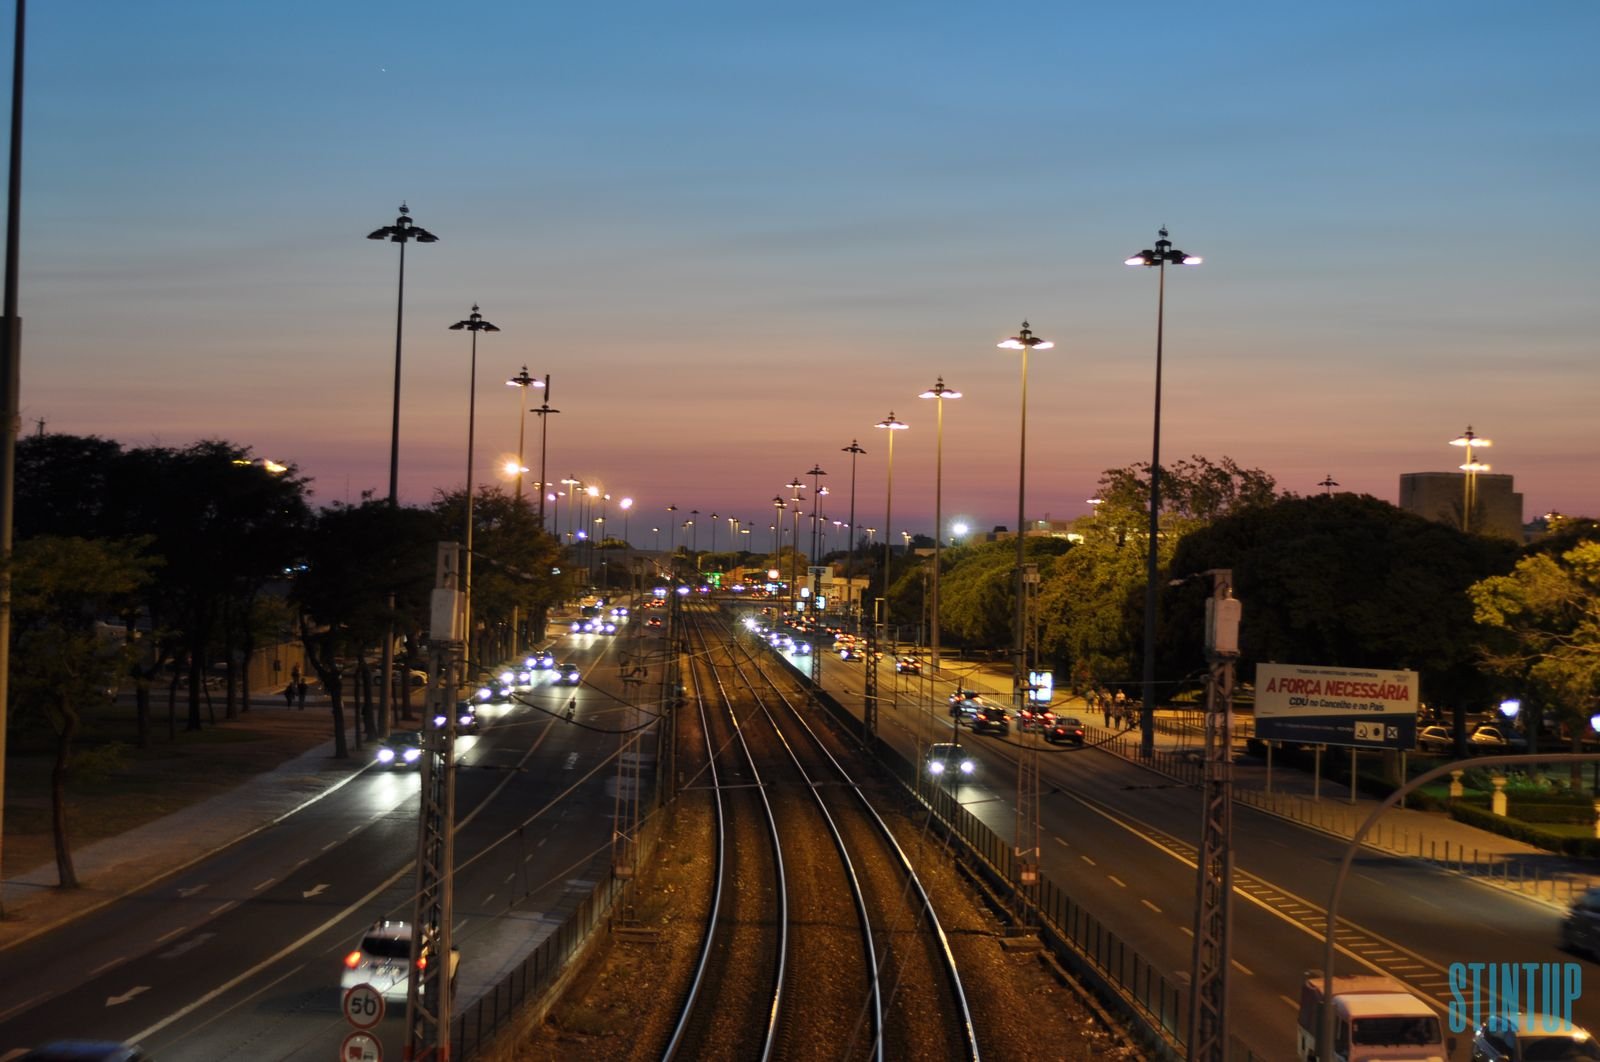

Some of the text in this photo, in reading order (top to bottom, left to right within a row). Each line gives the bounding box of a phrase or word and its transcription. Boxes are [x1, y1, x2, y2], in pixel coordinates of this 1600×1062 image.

[1266, 677, 1409, 701] A FORÇA NECESSÁRIA
[1289, 697, 1309, 706] CDU
[1319, 699, 1353, 709] Concelho
[351, 997, 376, 1016] 50
